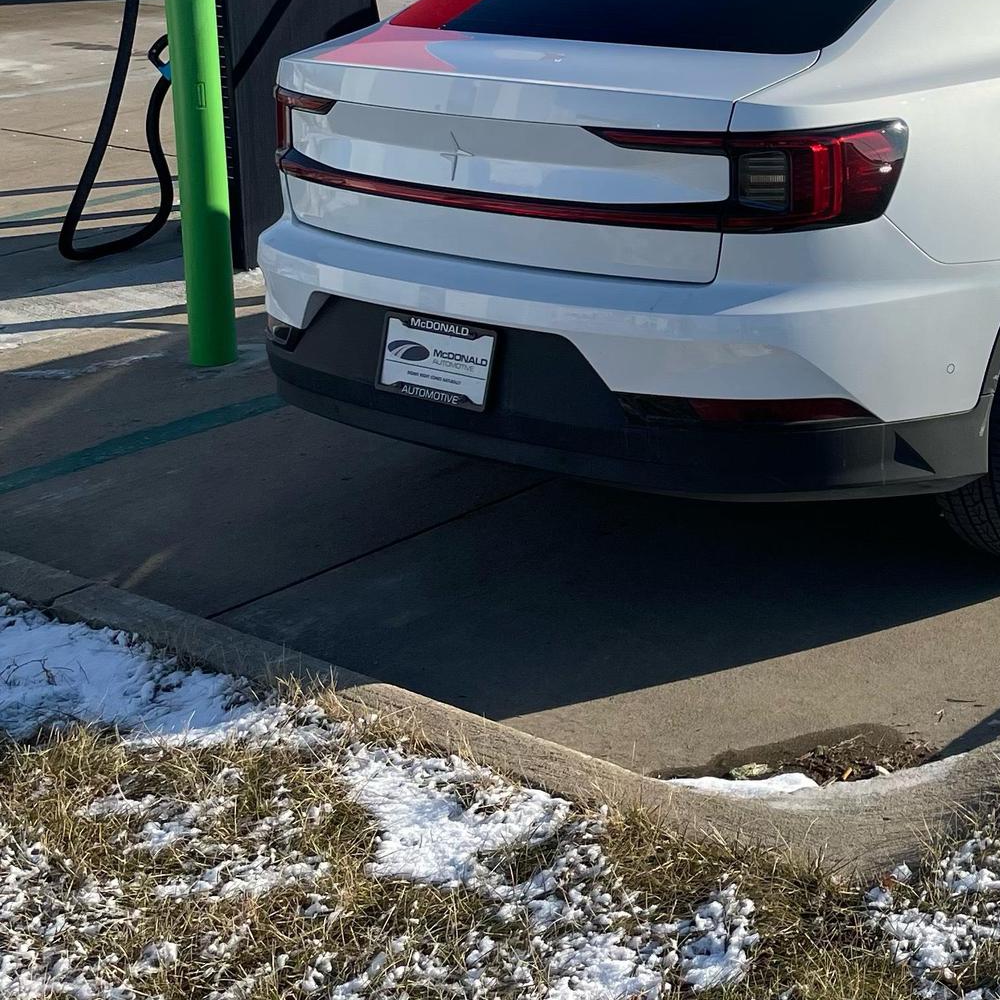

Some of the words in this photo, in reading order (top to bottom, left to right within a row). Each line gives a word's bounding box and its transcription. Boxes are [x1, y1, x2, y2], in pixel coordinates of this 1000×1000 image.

[410, 317, 469, 336] McDONALD
[432, 359, 475, 373] AUTOMOTIVE
[433, 348, 488, 367] McDONALD
[401, 384, 459, 405] AUTOMOTIVE
